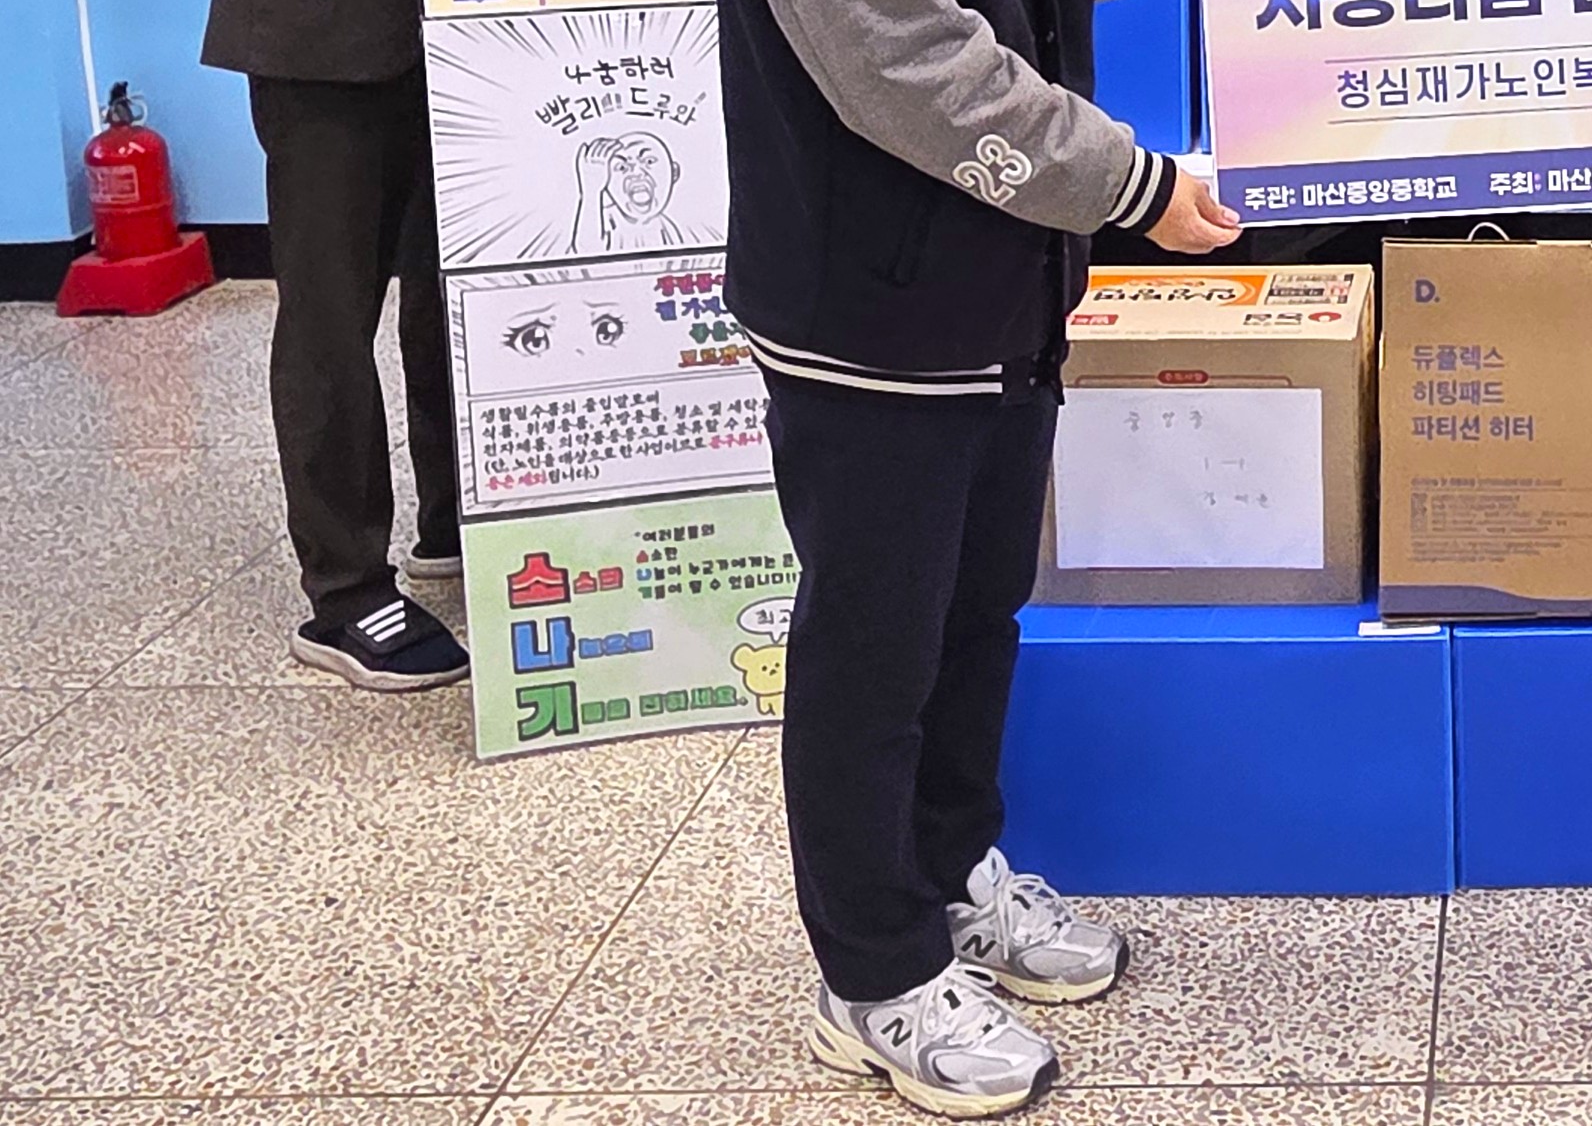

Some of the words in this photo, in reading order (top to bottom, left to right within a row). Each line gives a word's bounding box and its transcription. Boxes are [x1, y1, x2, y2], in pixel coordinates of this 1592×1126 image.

[565, 55, 674, 86] 나눔하러
[953, 134, 1032, 206] 23
[1244, 184, 1296, 210] 주관:
[1301, 175, 1457, 208] 마산중앙중학교
[1489, 172, 1543, 196] 주최:
[1415, 279, 1440, 303] D.
[1412, 345, 1505, 371] 듀플렉스
[1412, 380, 1505, 405] 히팅패드
[1412, 415, 1480, 441] 파티션
[1489, 415, 1534, 441] 히터
